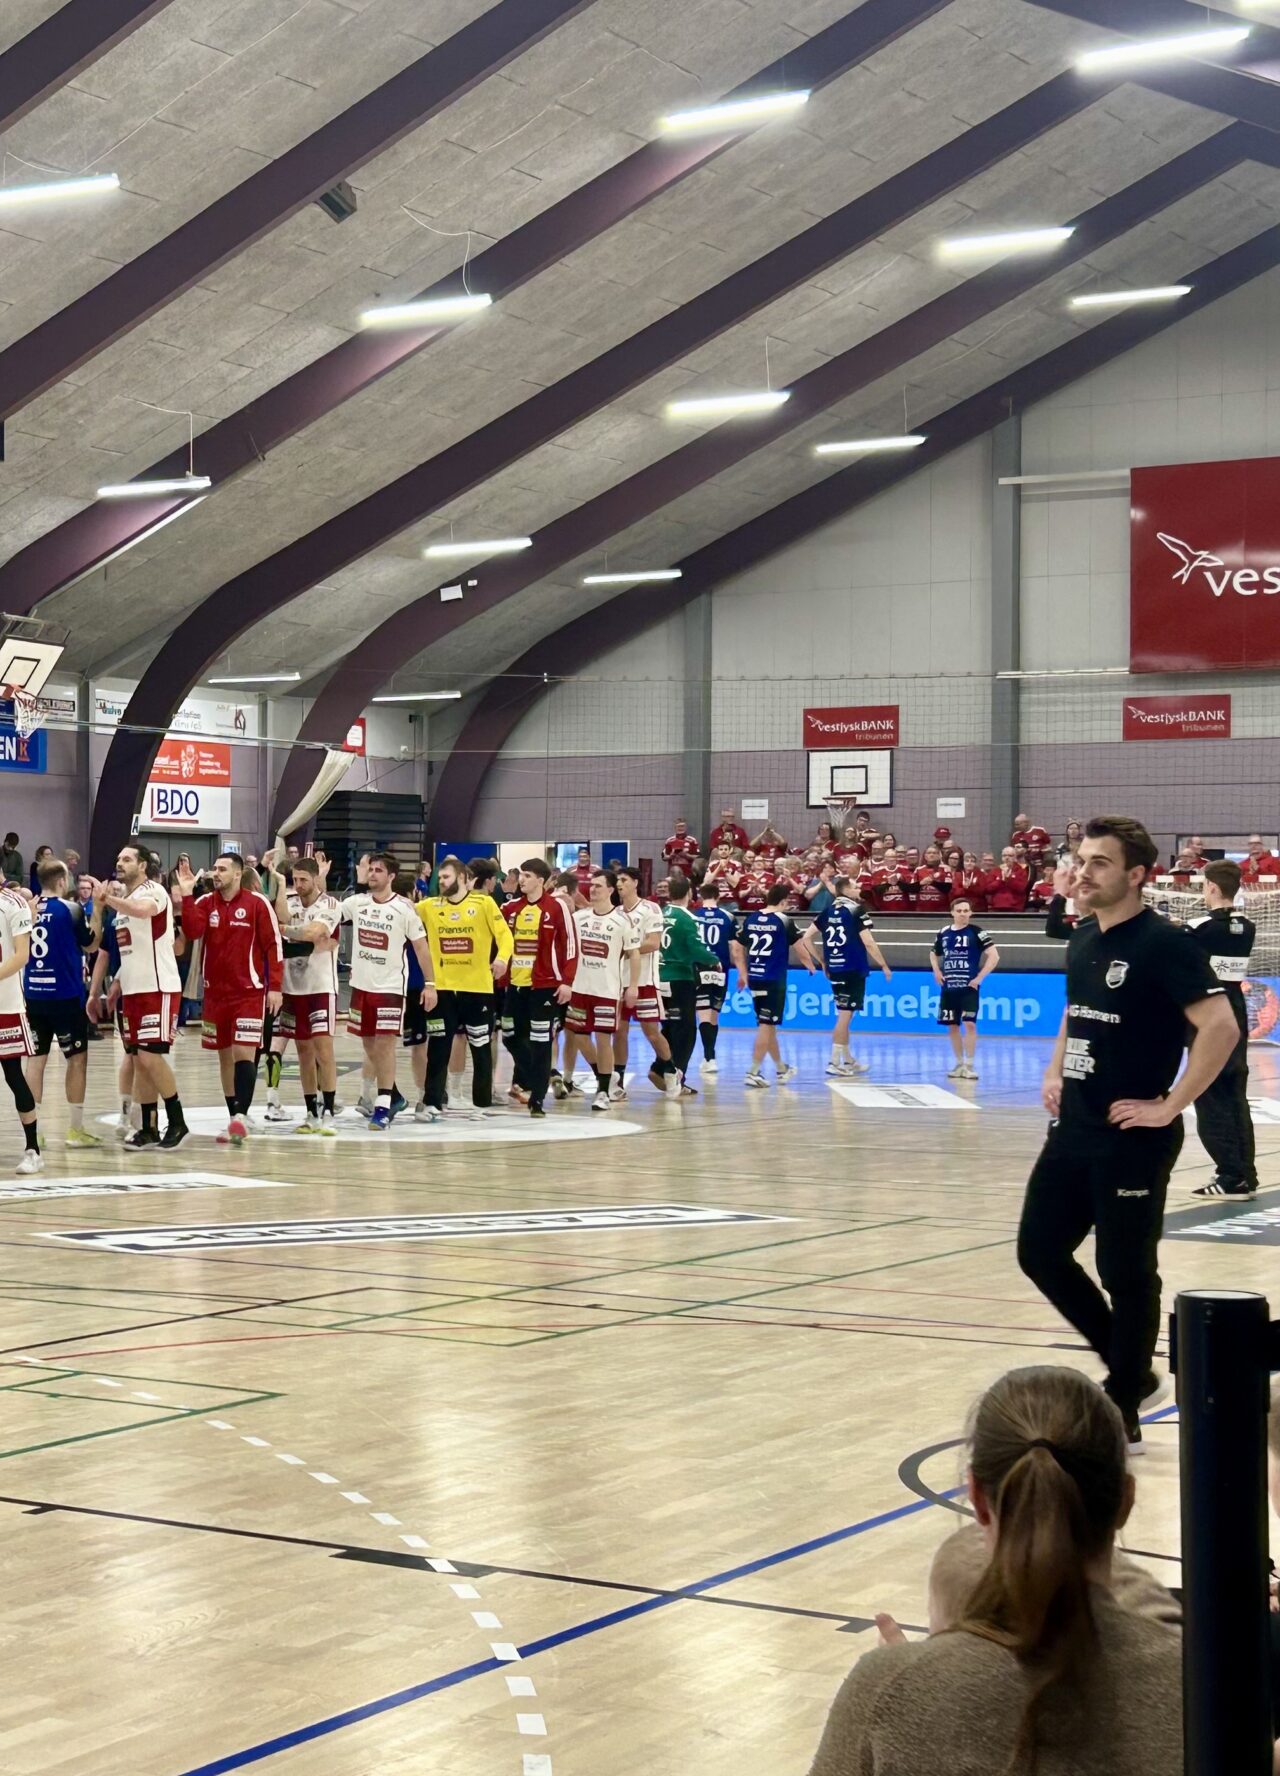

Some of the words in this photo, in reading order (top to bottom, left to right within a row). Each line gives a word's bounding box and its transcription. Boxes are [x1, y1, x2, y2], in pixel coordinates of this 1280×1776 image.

[157, 788, 199, 816] BDO
[31, 926, 48, 958] 8
[749, 933, 773, 956] 22
[825, 926, 847, 947] 23
[954, 936, 969, 947] 21
[943, 1009, 954, 1020] 21
[173, 1212, 681, 1242] PLACE2BOOK
